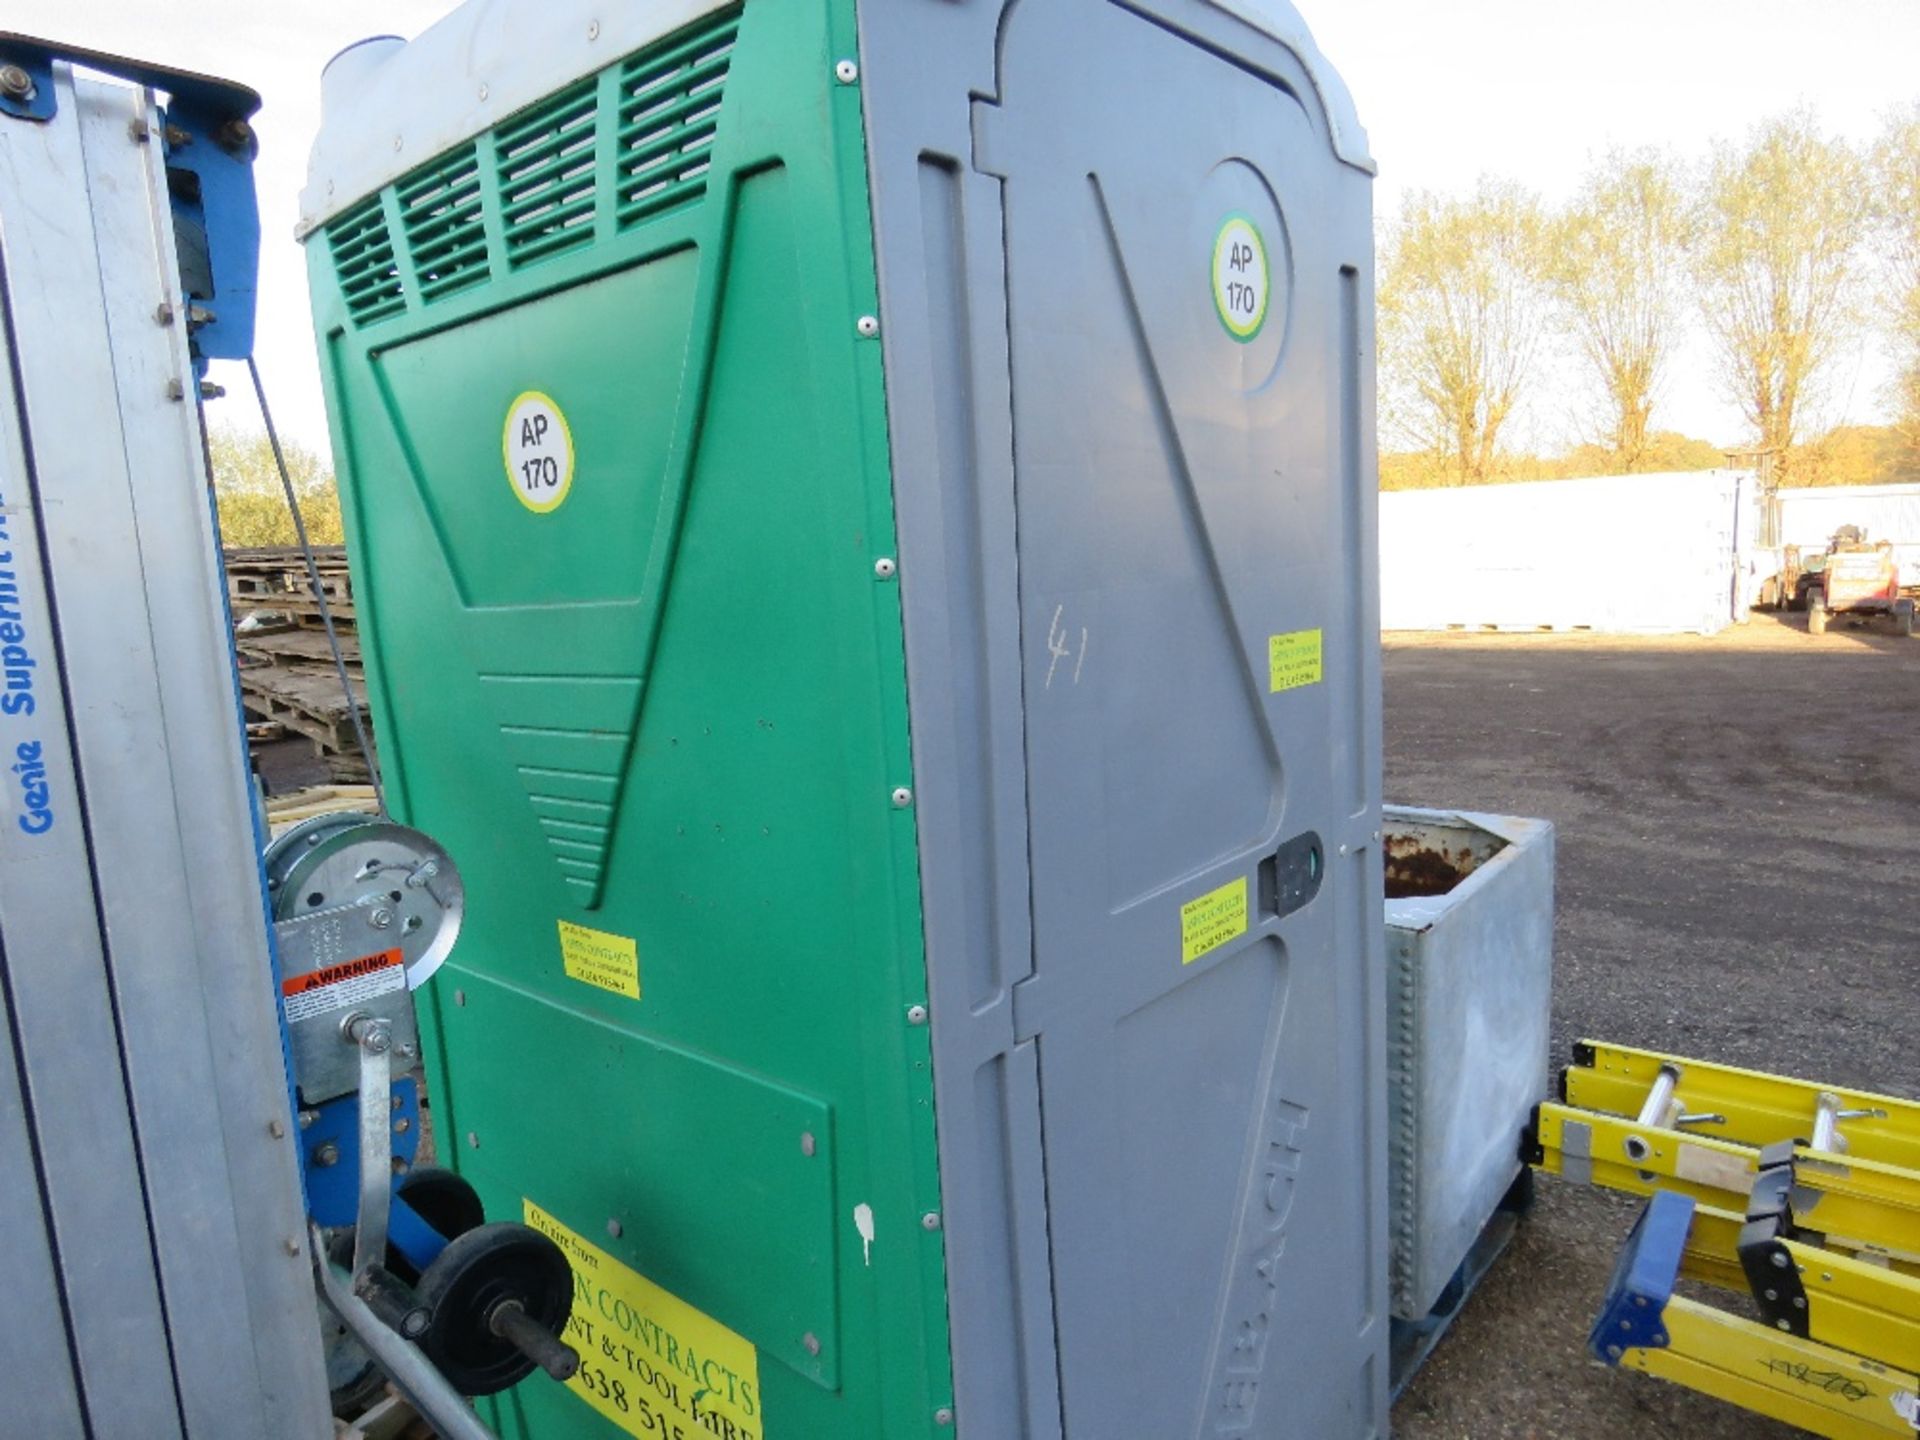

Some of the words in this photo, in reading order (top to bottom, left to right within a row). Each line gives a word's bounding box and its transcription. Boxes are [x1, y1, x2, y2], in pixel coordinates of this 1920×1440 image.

[1229, 241, 1253, 273] AP
[1226, 281, 1255, 314] 170
[521, 414, 548, 448] AP
[521, 456, 558, 490] 170
[11, 740, 54, 836] Genie
[318, 953, 388, 983] WARNING
[598, 1290, 754, 1416] CONTRACTS
[602, 1334, 619, 1362] &
[622, 1344, 686, 1413] TOOL
